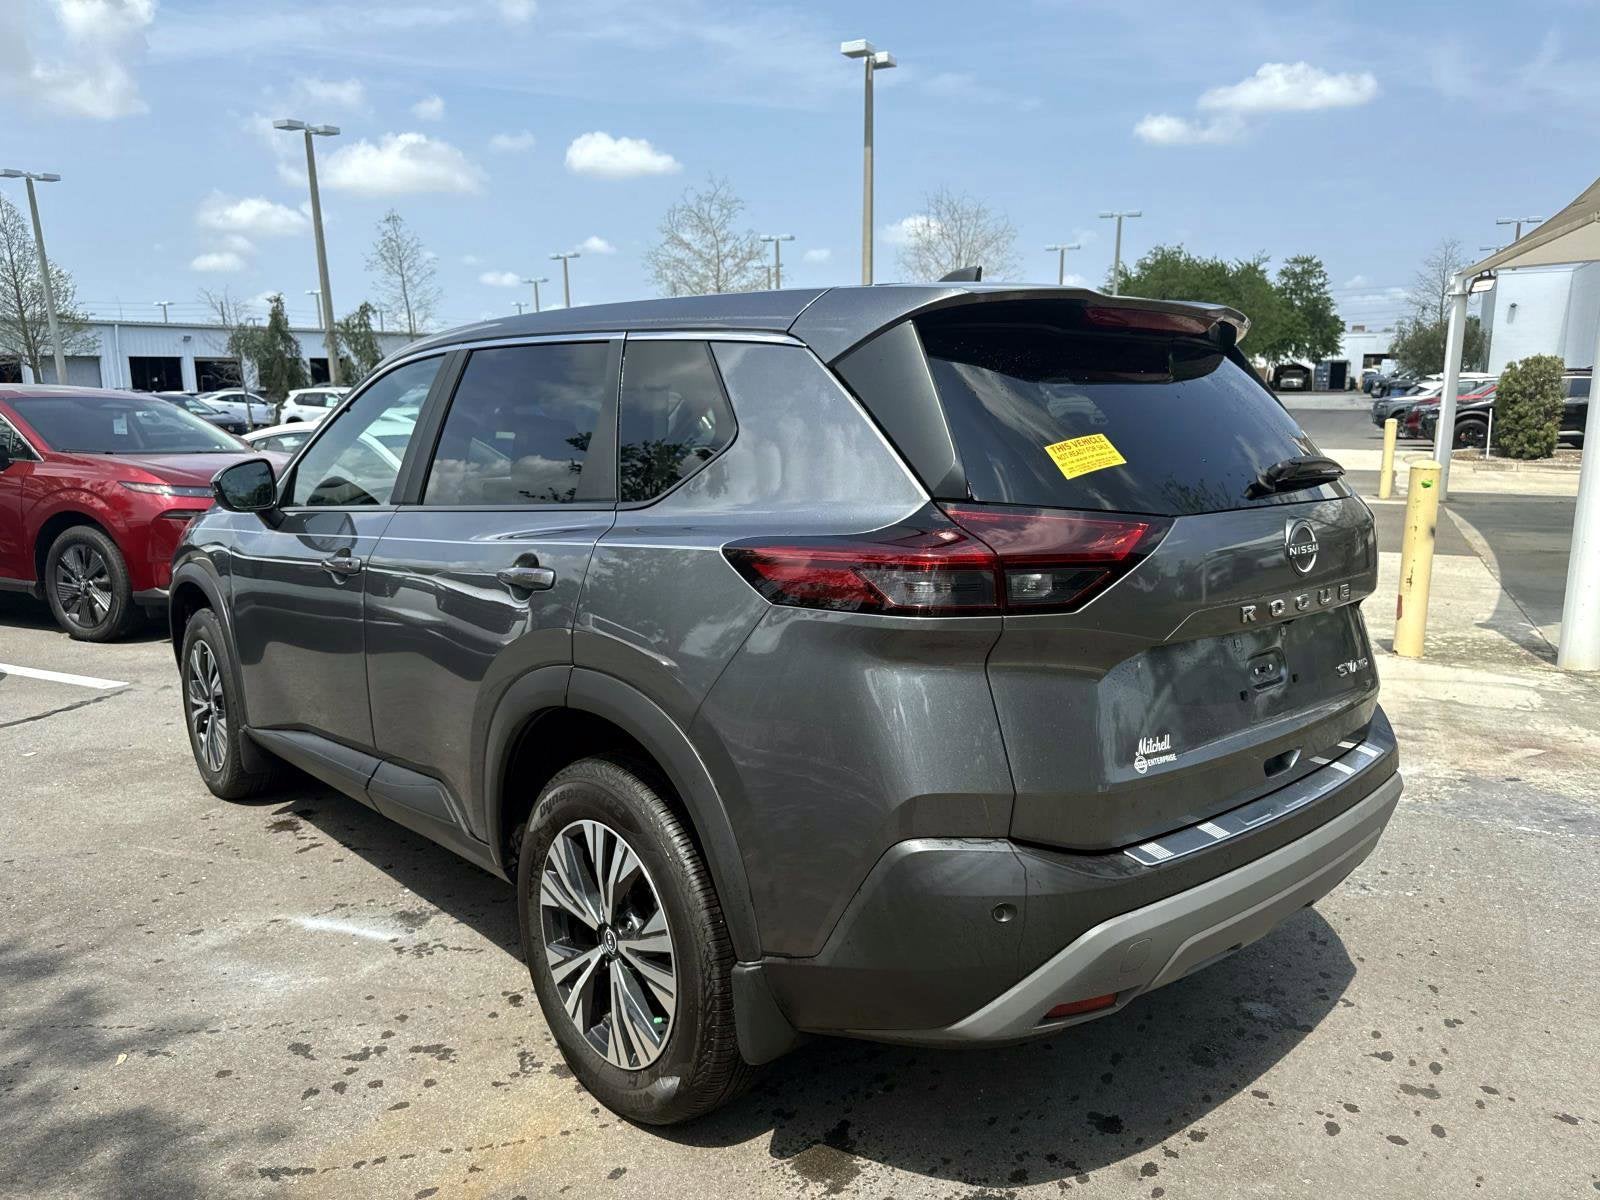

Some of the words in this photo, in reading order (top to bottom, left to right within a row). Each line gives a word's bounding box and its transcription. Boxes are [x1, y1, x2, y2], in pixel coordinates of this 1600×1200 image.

[1050, 442, 1072, 454] THIS
[1070, 435, 1105, 448] VEHICLE
[1289, 542, 1319, 556] NISSAN
[1240, 583, 1351, 624] ROGUE
[1336, 660, 1357, 678] SV
[1135, 733, 1171, 756] Mitchell
[1147, 753, 1177, 767] ENTERPRISE
